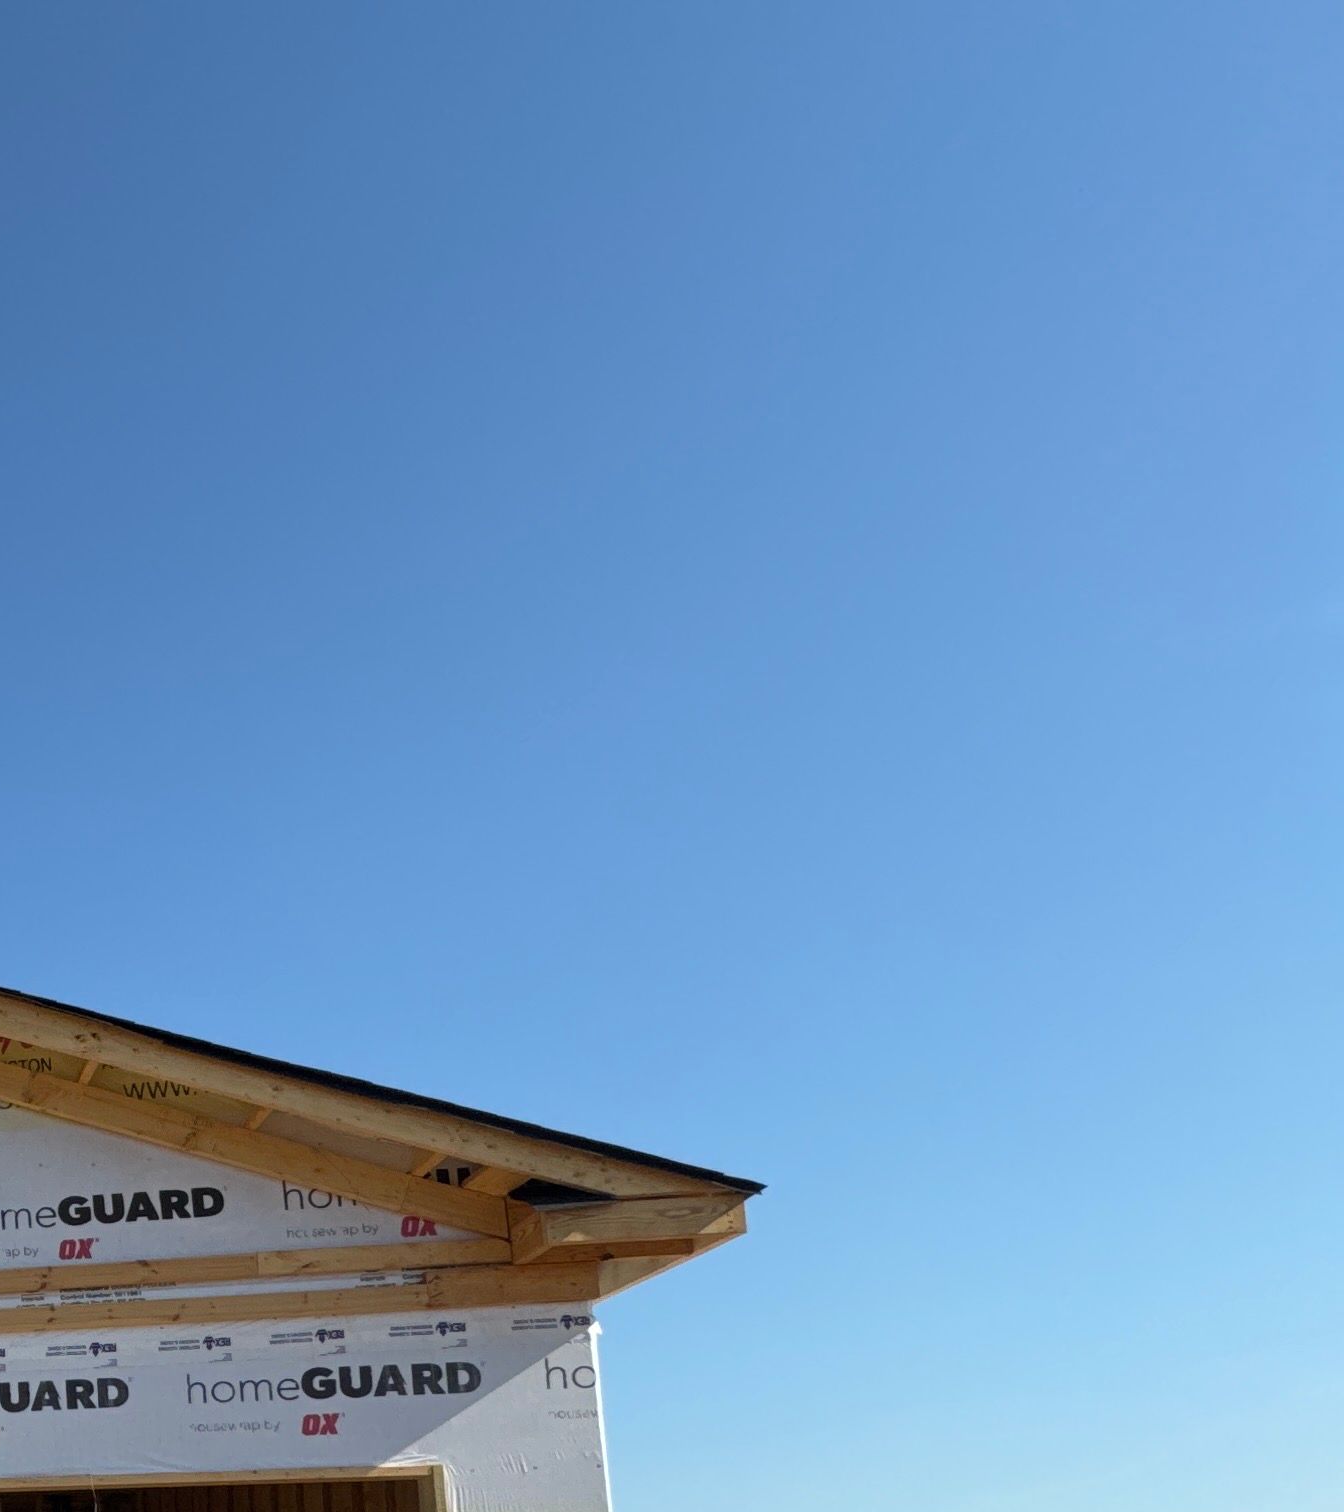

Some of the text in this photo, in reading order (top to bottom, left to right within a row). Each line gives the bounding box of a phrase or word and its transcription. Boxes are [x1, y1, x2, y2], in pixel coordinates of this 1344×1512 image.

[400, 1216, 438, 1238] OX
[58, 1237, 95, 1260] OX
[186, 1360, 483, 1404] homeGUARD
[301, 1412, 340, 1435] OX
